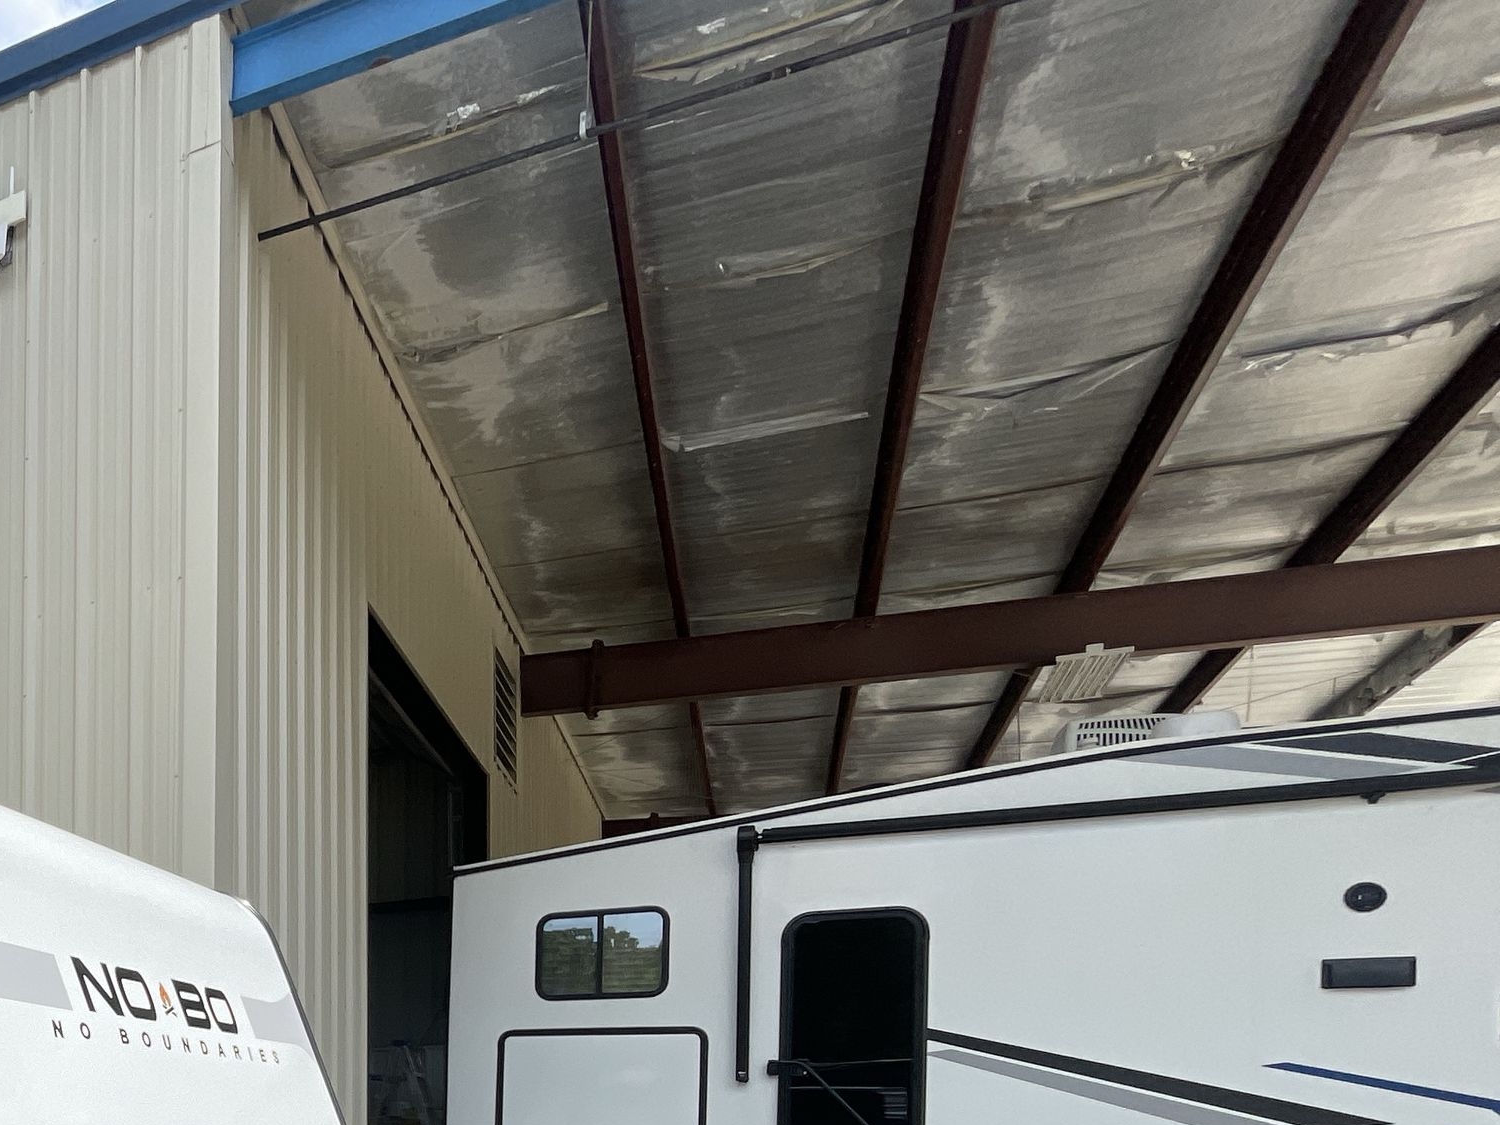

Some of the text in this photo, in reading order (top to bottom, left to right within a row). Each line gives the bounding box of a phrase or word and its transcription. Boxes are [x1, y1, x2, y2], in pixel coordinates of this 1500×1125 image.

[70, 956, 238, 1034] NO BO
[52, 1019, 280, 1065] NO BOUNDARIES
